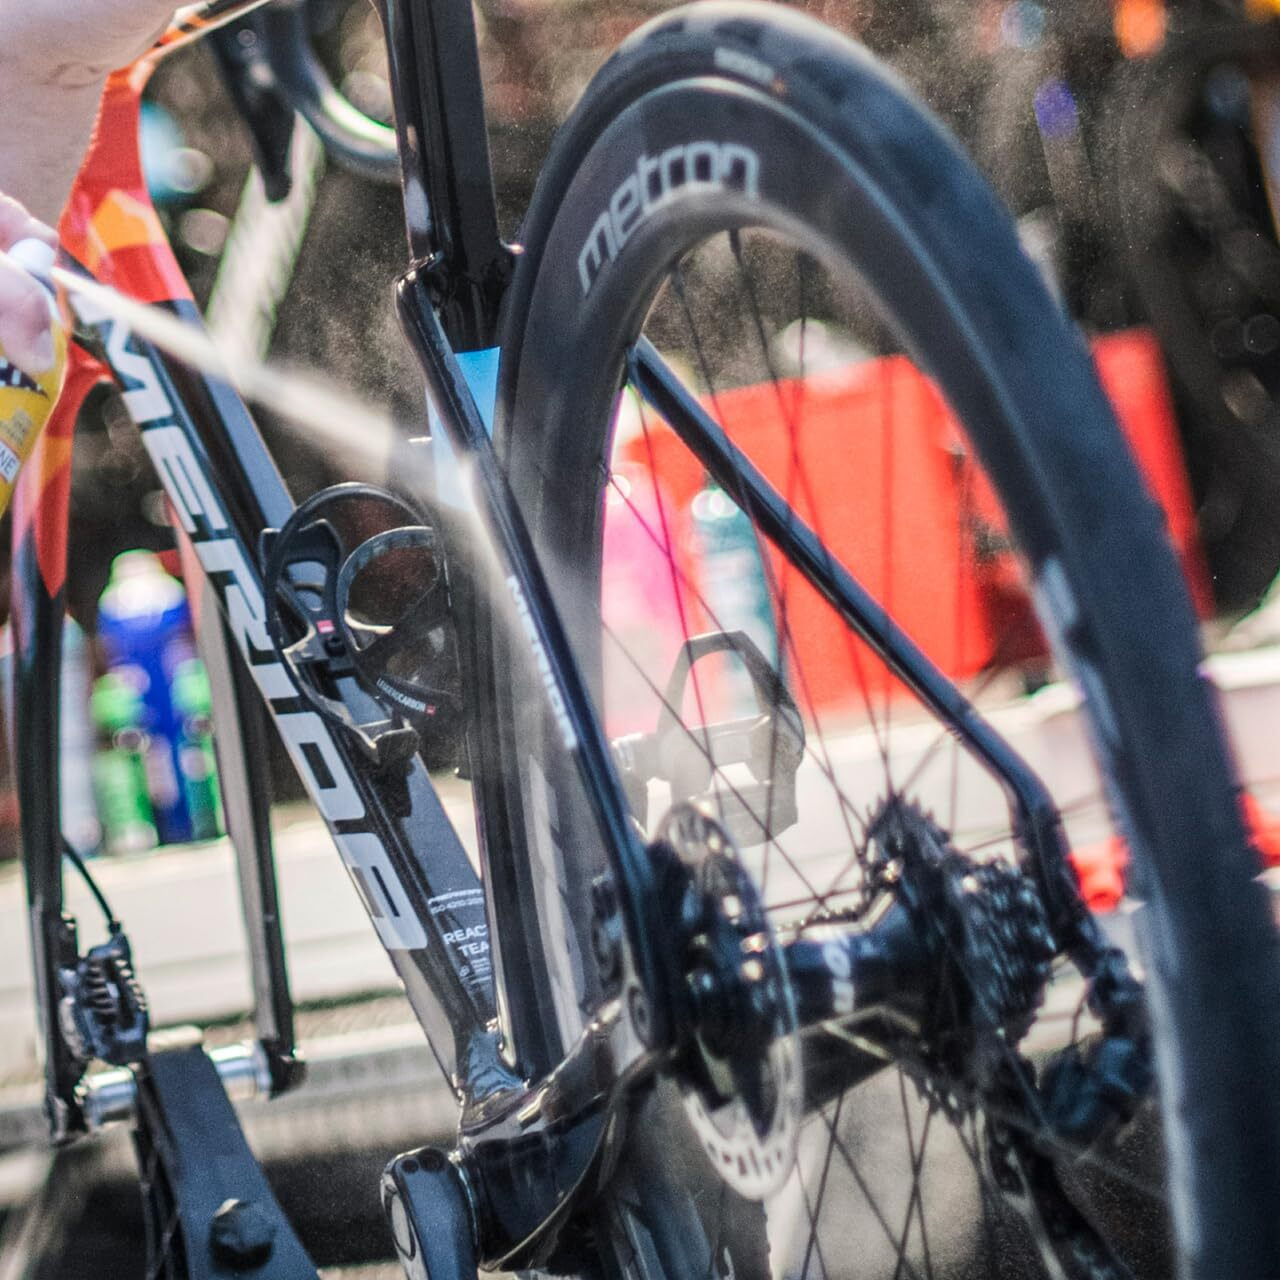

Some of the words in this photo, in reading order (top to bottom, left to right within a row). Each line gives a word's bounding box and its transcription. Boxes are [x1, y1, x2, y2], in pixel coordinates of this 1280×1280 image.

[577, 140, 760, 297] metron
[69, 282, 428, 950] MERIDA
[442, 923, 487, 945] REAC
[457, 940, 490, 957] TEA
